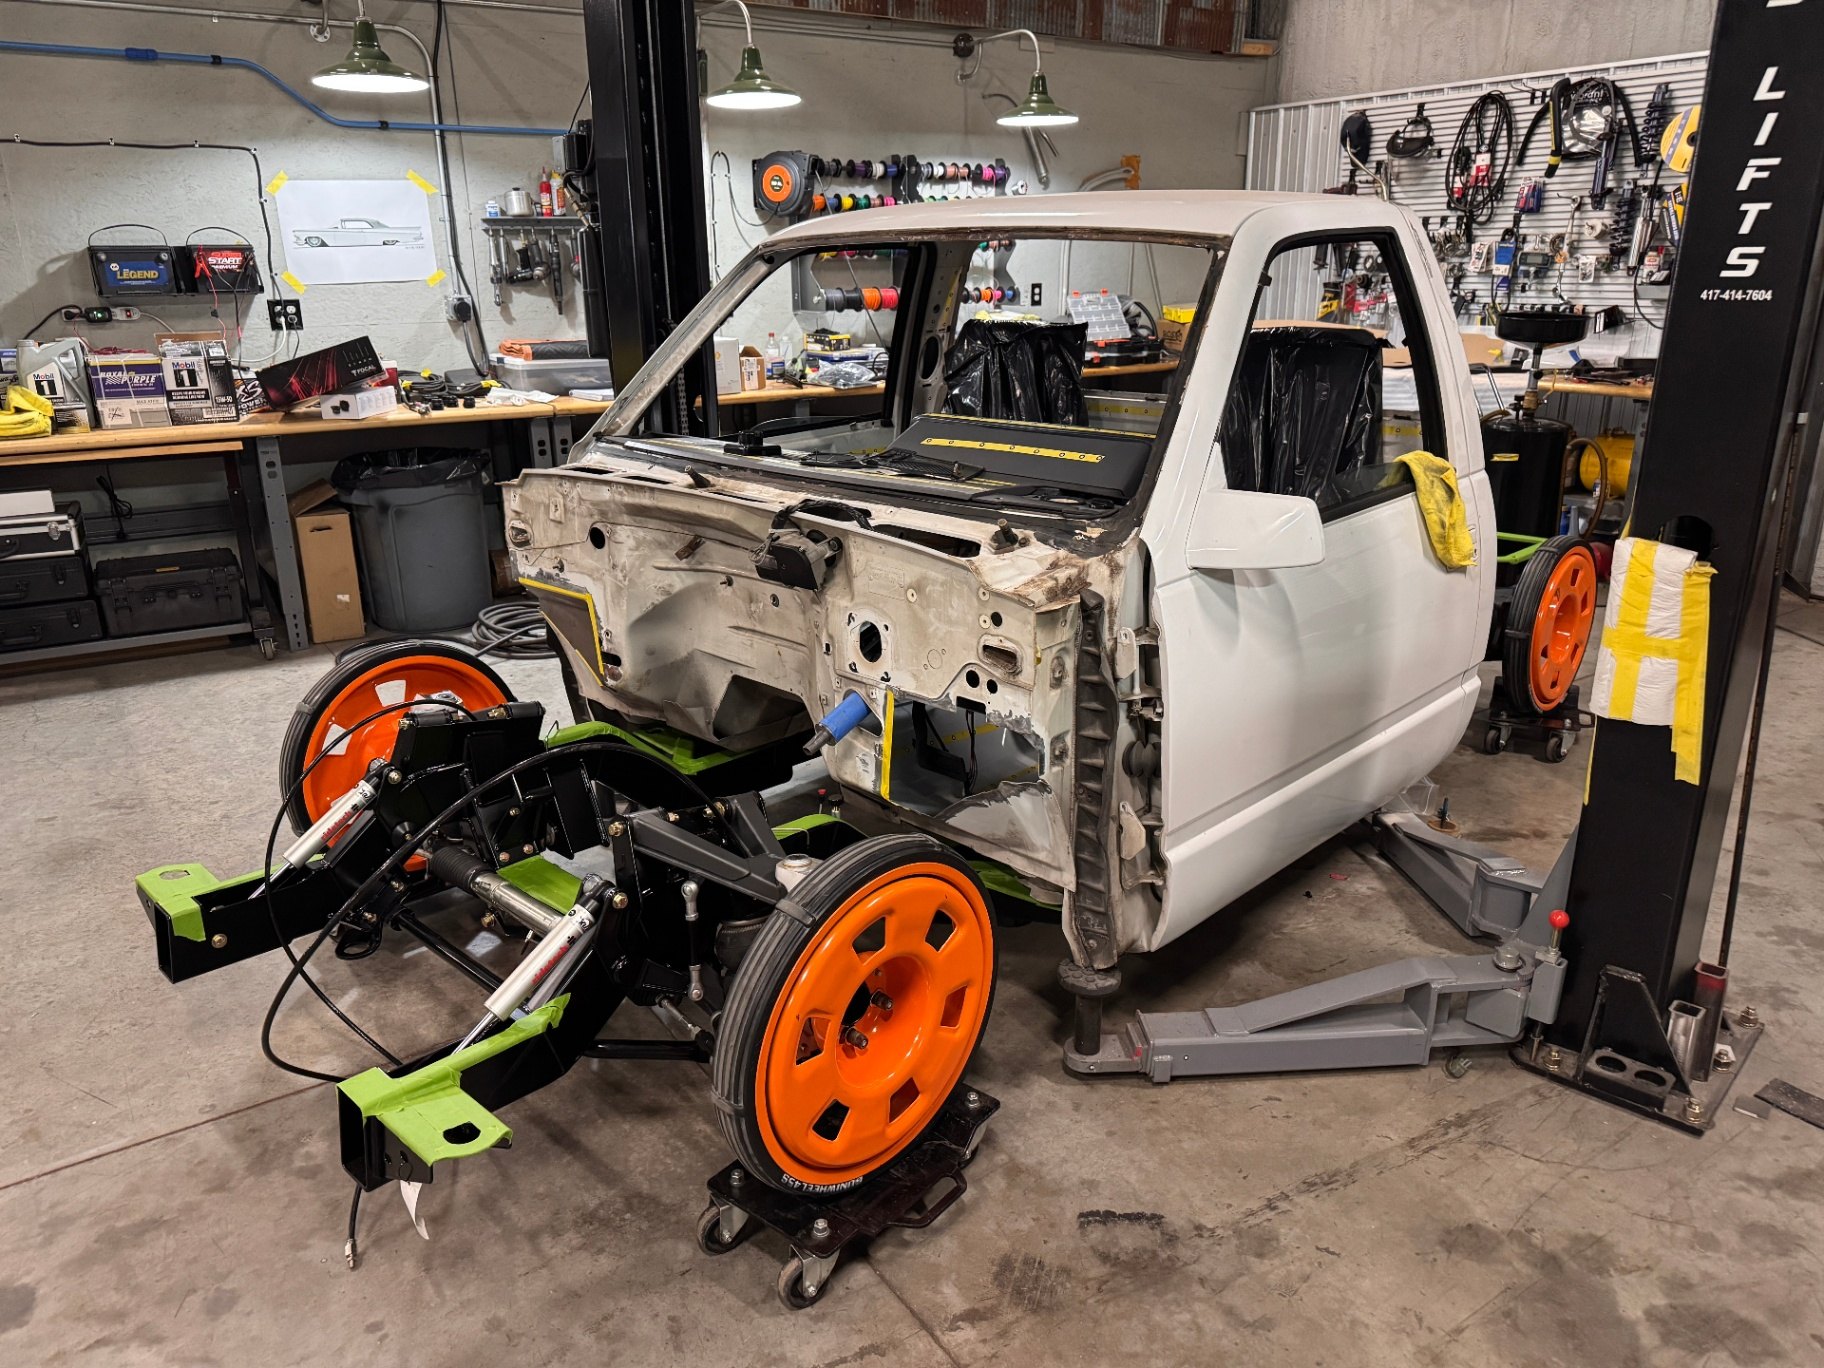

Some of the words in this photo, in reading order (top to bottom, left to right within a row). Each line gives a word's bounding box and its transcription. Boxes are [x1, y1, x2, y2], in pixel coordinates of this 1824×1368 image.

[1719, 66, 1787, 278] LIFTS
[208, 256, 243, 265] START
[117, 269, 159, 280] LEGEND
[1700, 289, 1773, 301] 417-414-7604
[171, 361, 196, 369] Mobil
[32, 372, 55, 380] Mobil
[180, 369, 191, 387] 1
